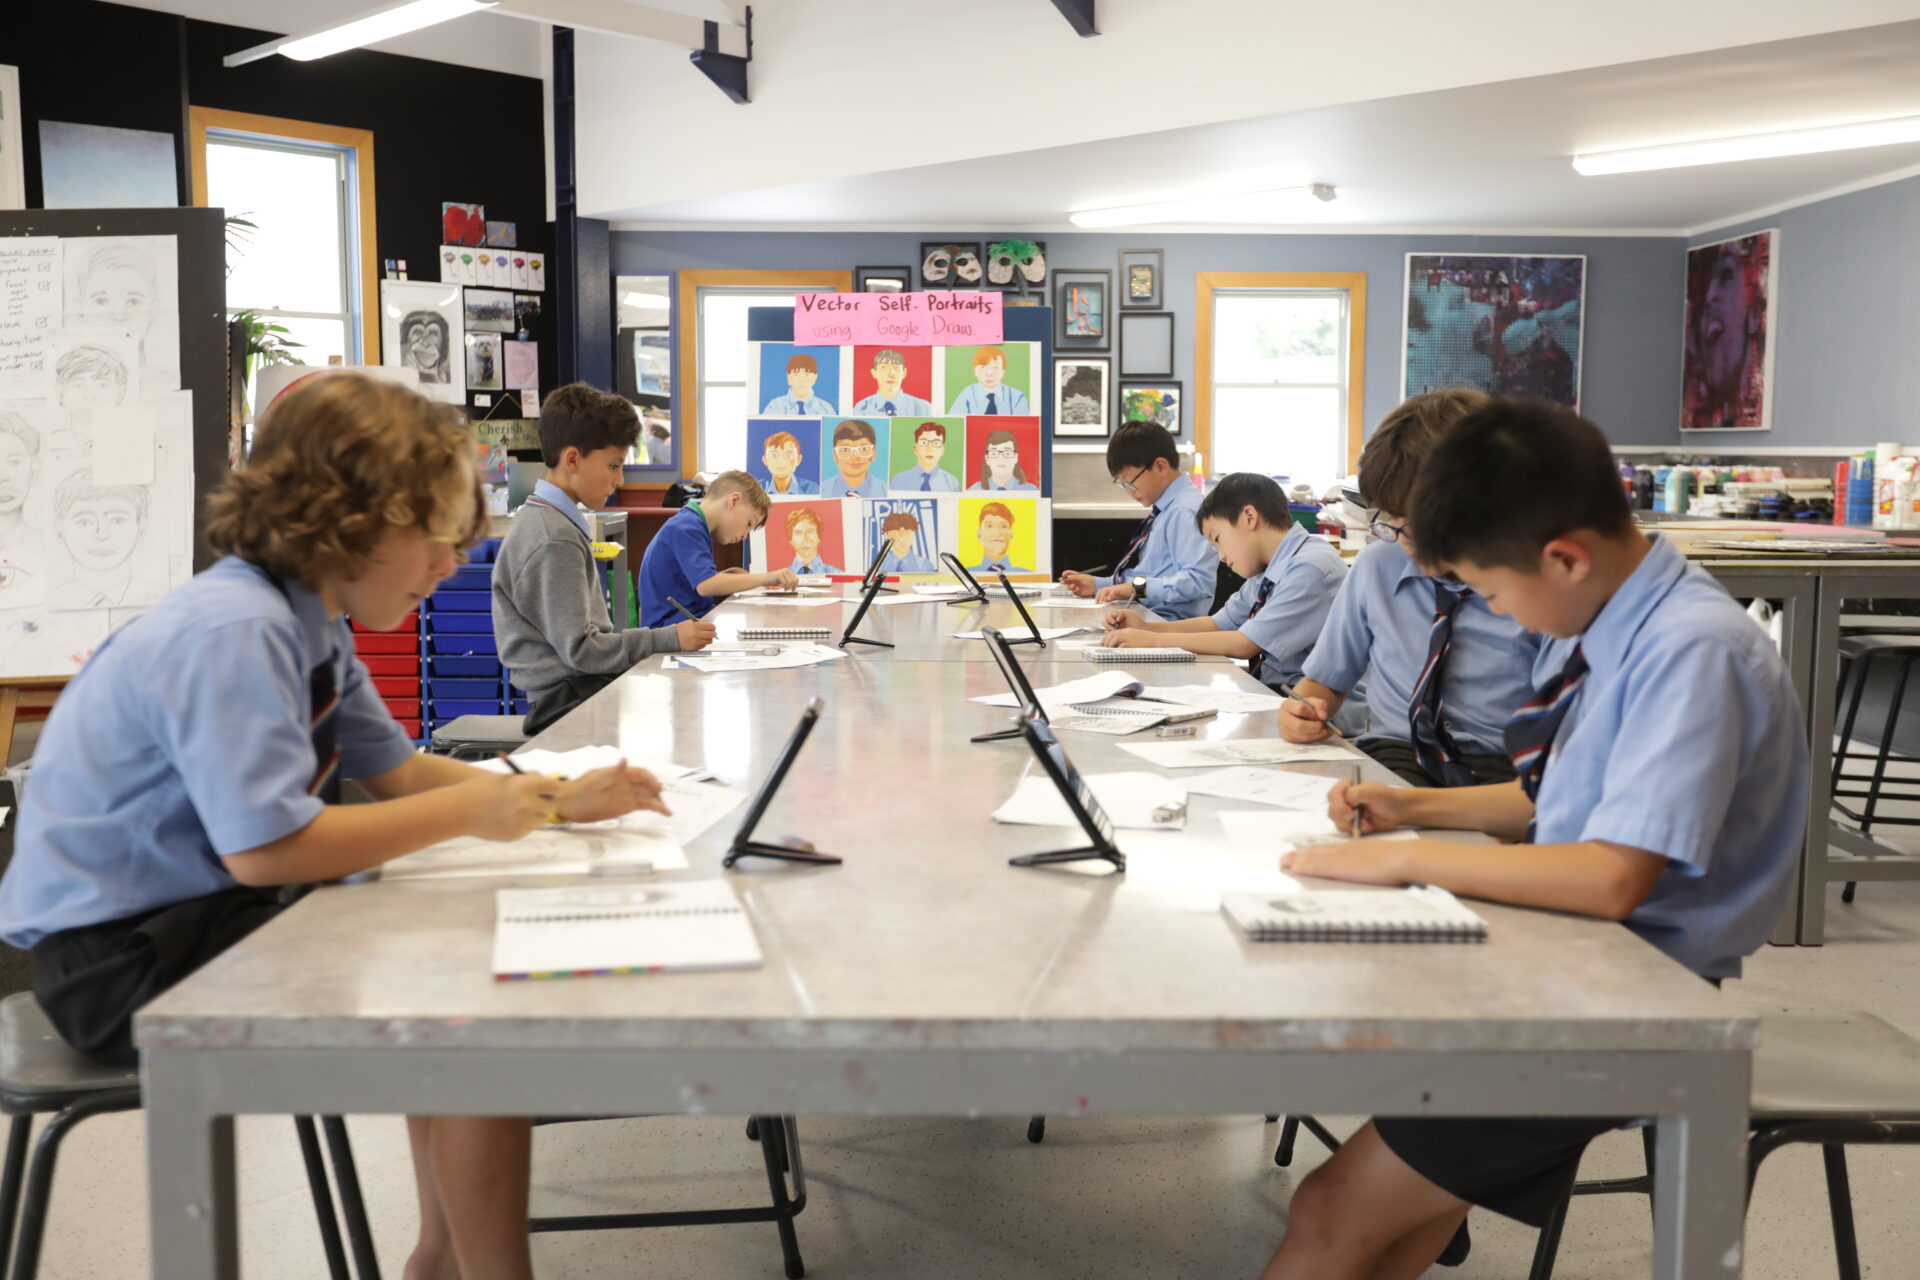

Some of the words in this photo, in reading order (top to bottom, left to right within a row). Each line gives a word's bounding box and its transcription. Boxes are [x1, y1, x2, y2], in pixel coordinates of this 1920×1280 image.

[802, 294, 860, 312] Vector
[927, 293, 993, 314] Portraits
[813, 325, 852, 341] using
[877, 316, 921, 343] Google
[932, 315, 973, 336] Draw
[478, 423, 523, 435] Cherish
